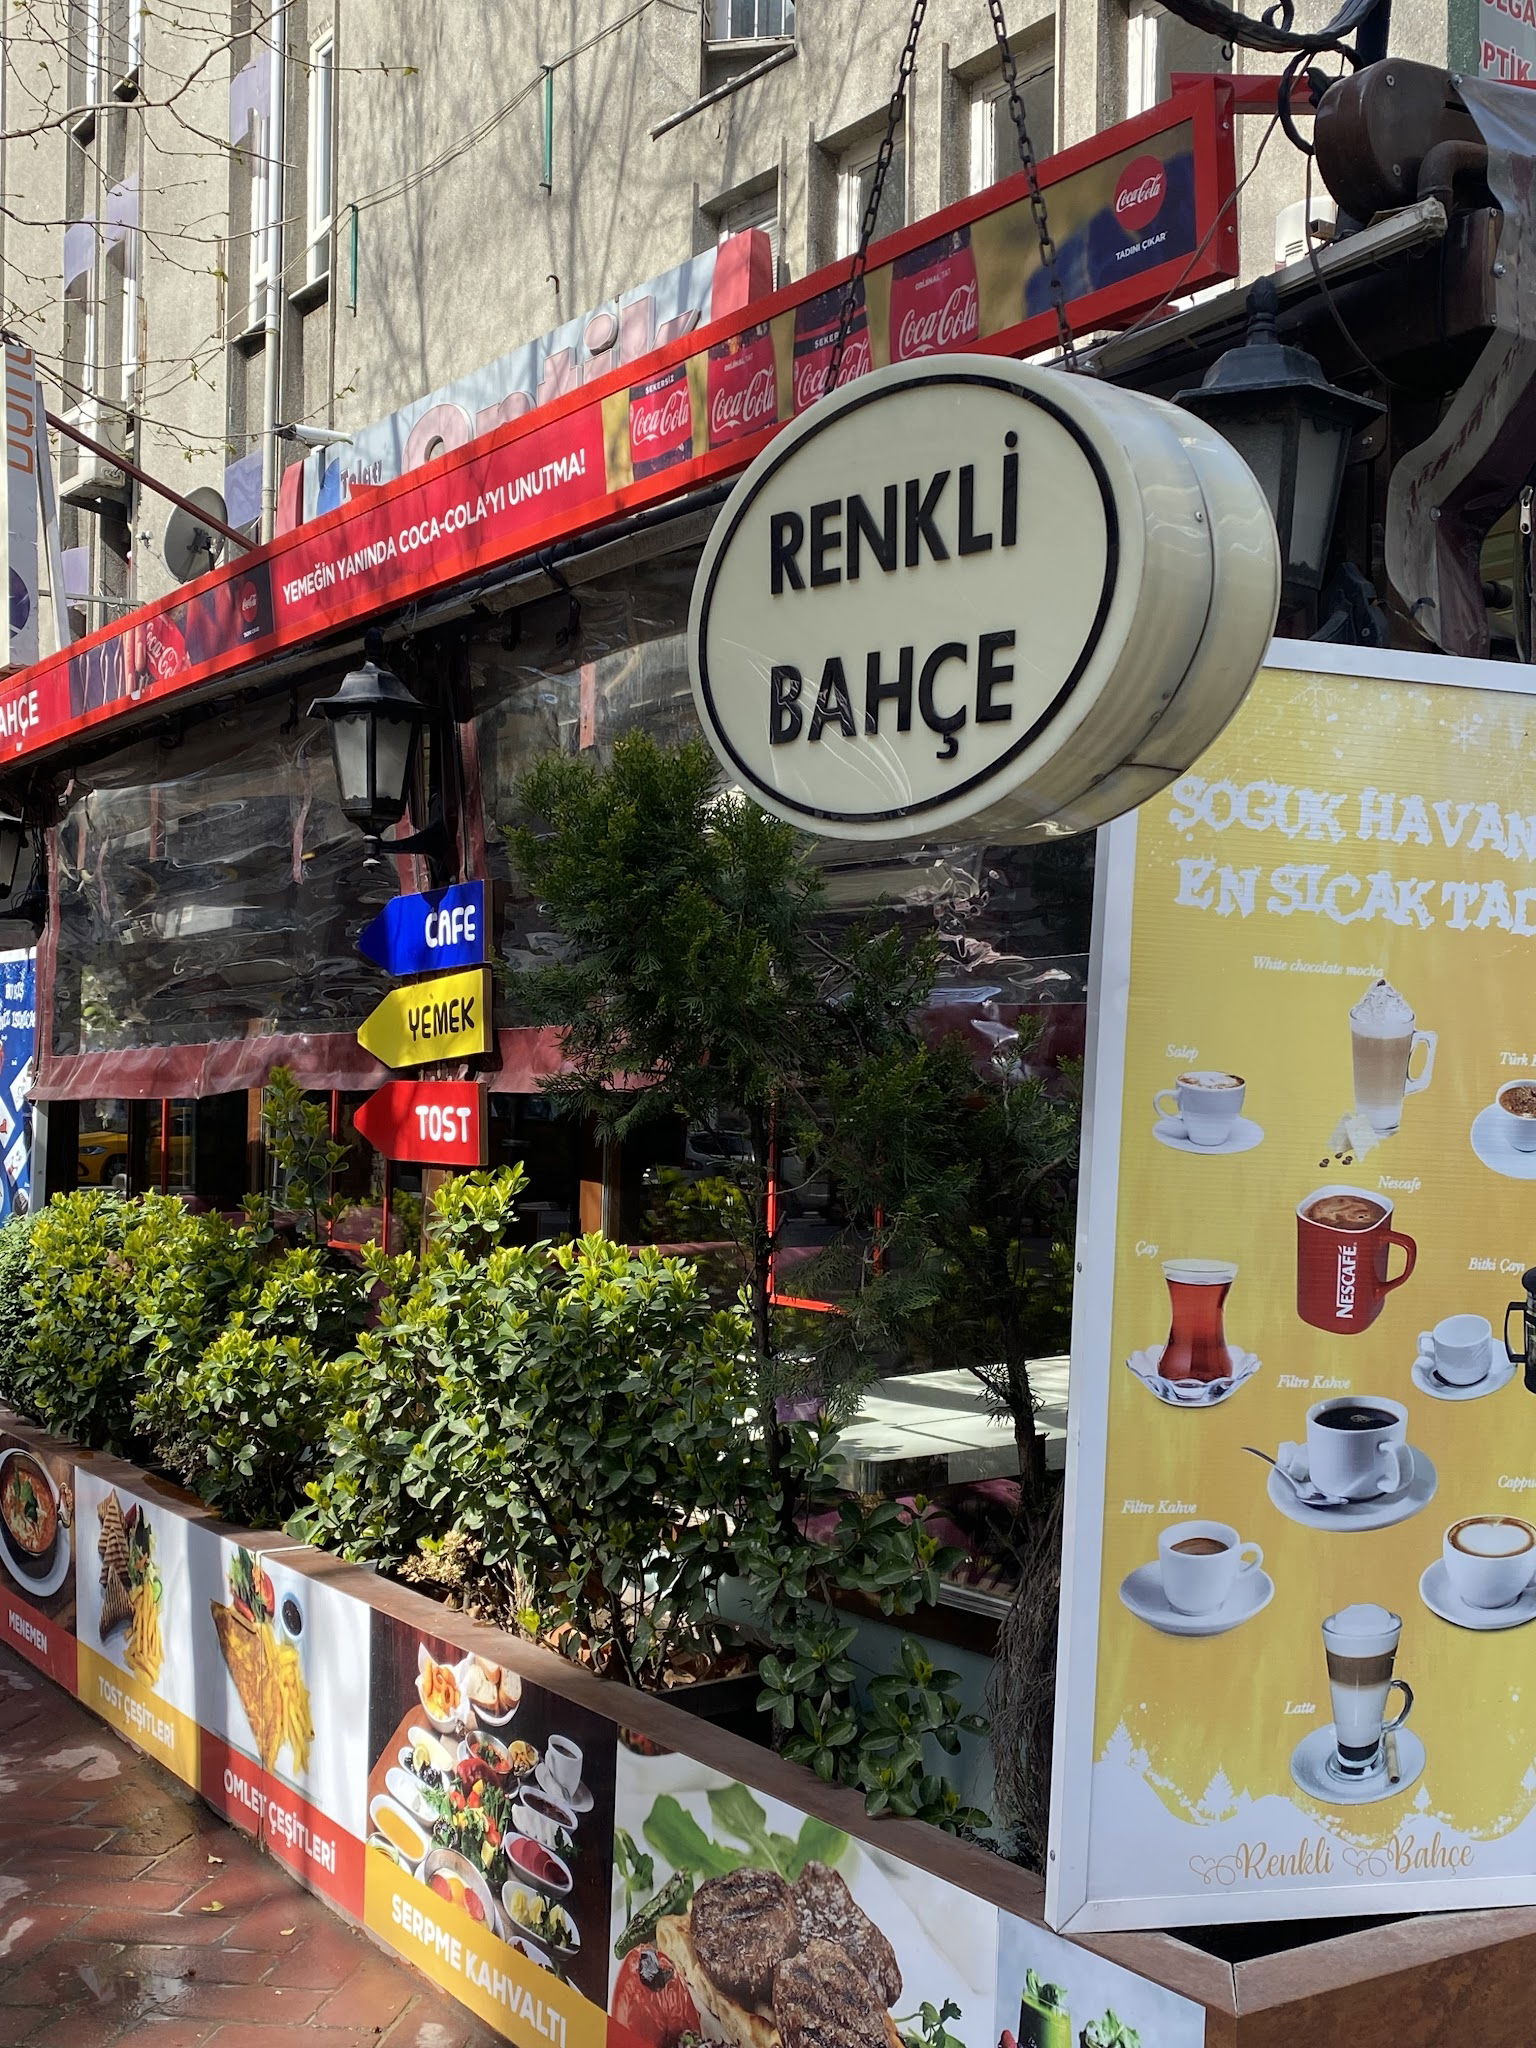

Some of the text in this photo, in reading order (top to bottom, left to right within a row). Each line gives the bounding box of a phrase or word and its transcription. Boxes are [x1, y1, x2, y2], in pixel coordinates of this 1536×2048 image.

[1115, 232, 1166, 260] TADINI ÇIKAR
[901, 279, 978, 359] Coca-Cola
[633, 385, 689, 446] Coca-Cola
[712, 364, 776, 433] Coca-Cola
[282, 561, 336, 605] YEMEĞİN
[337, 535, 397, 579] YANINDA
[508, 448, 586, 506] UNUTMA!
[770, 430, 1019, 595] RENKLİ
[769, 629, 1017, 760] BAHÇE
[1174, 853, 1262, 918] EN
[1266, 864, 1436, 931] SICAK
[425, 904, 476, 948] CAFE
[1253, 955, 1385, 978] White chocolate mocha
[408, 996, 475, 1042] YEMEK
[1166, 1044, 1199, 1063] Salep
[1500, 1051, 1528, 1066] Türk
[415, 1105, 471, 1143] TOST
[1378, 1175, 1421, 1194] Nescafe
[1336, 1244, 1357, 1319] NESCAFÉ
[1468, 1257, 1526, 1276] Bitki Çayı
[1277, 1374, 1351, 1389] Filtre Kahve
[1121, 1499, 1198, 1514] Filtre Kahve
[8, 1609, 48, 1654] MENEMEN
[99, 1675, 175, 1750] TOST ÇEŞİTLERİ
[1284, 1701, 1316, 1715] Latte
[223, 1768, 336, 1875] OMLET ÇEŞİTLERİ
[1236, 1831, 1475, 1880] Renkli Bahçe
[392, 1893, 567, 2048] SERPME KAHVALTI
